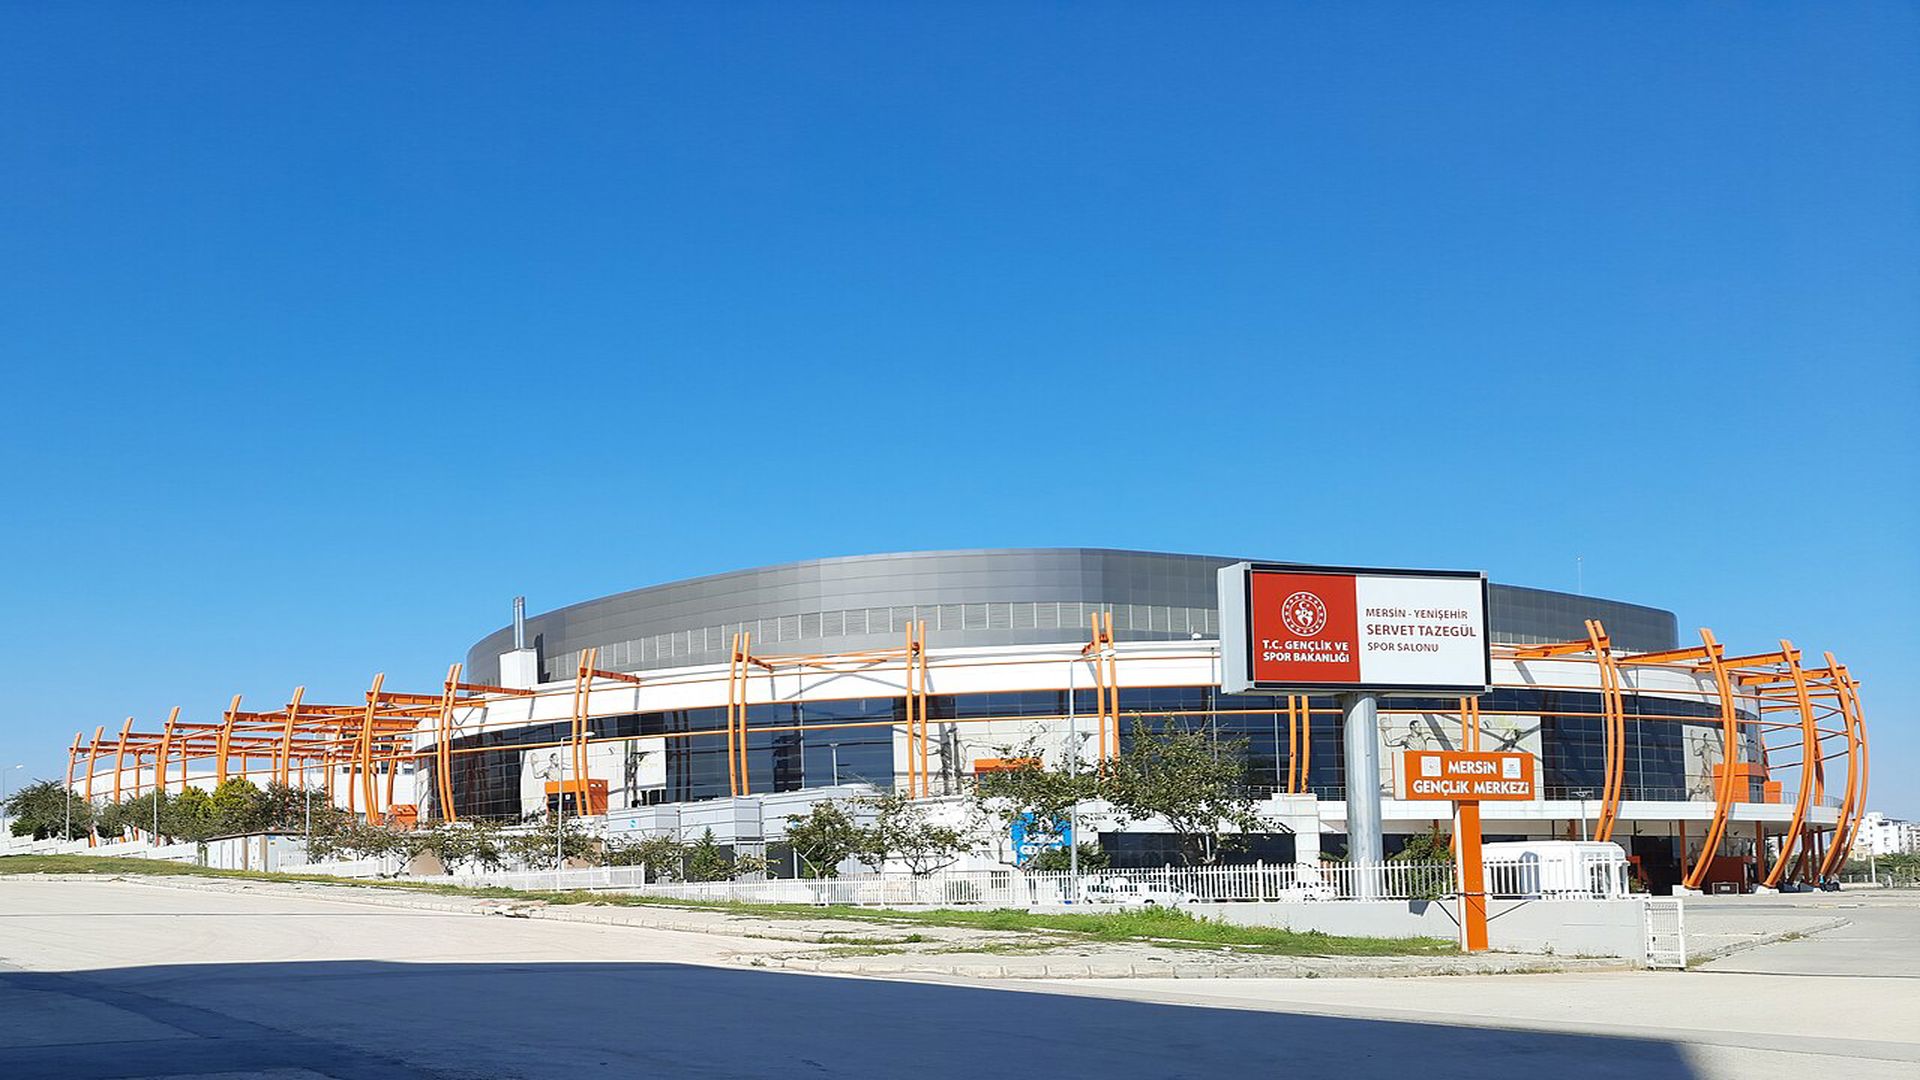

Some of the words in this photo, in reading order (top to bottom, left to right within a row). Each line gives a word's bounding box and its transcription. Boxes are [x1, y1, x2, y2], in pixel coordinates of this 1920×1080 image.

[1365, 607, 1406, 618] MERSİN
[1414, 608, 1468, 621] YENİŞEHİR
[1366, 624, 1416, 636] SERVET
[1417, 624, 1476, 637] TAZEGÜL
[1262, 639, 1283, 649] T.C.
[1285, 639, 1333, 652] GENÇLİK
[1335, 641, 1348, 651] VE
[1367, 642, 1395, 652] SPOR
[1397, 642, 1439, 652] SALONU
[1263, 652, 1291, 662] SPOR
[1293, 651, 1349, 663] BAKANLIĞI
